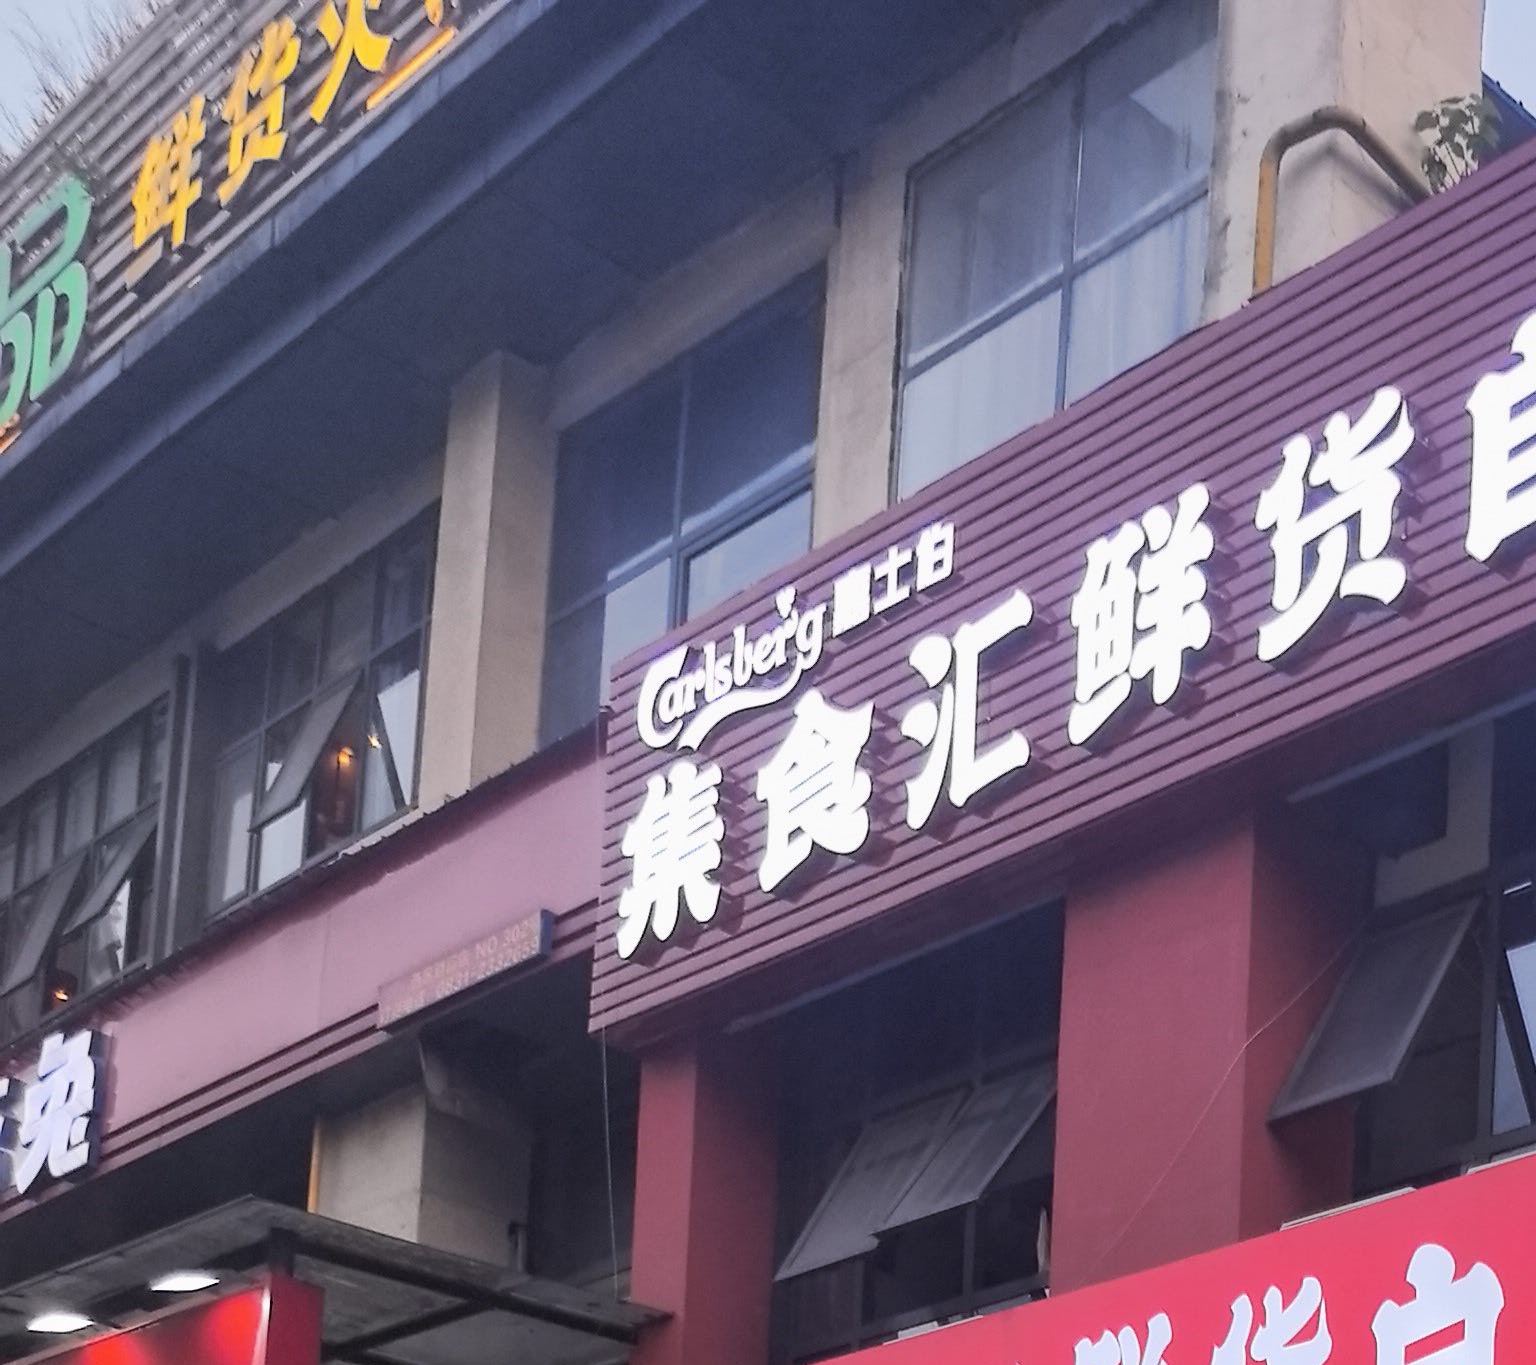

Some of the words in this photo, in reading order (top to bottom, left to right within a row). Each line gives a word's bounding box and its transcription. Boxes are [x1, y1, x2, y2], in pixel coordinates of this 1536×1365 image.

[132, 0, 446, 249] 鲜货火
[637, 586, 827, 751] Carlsberg
